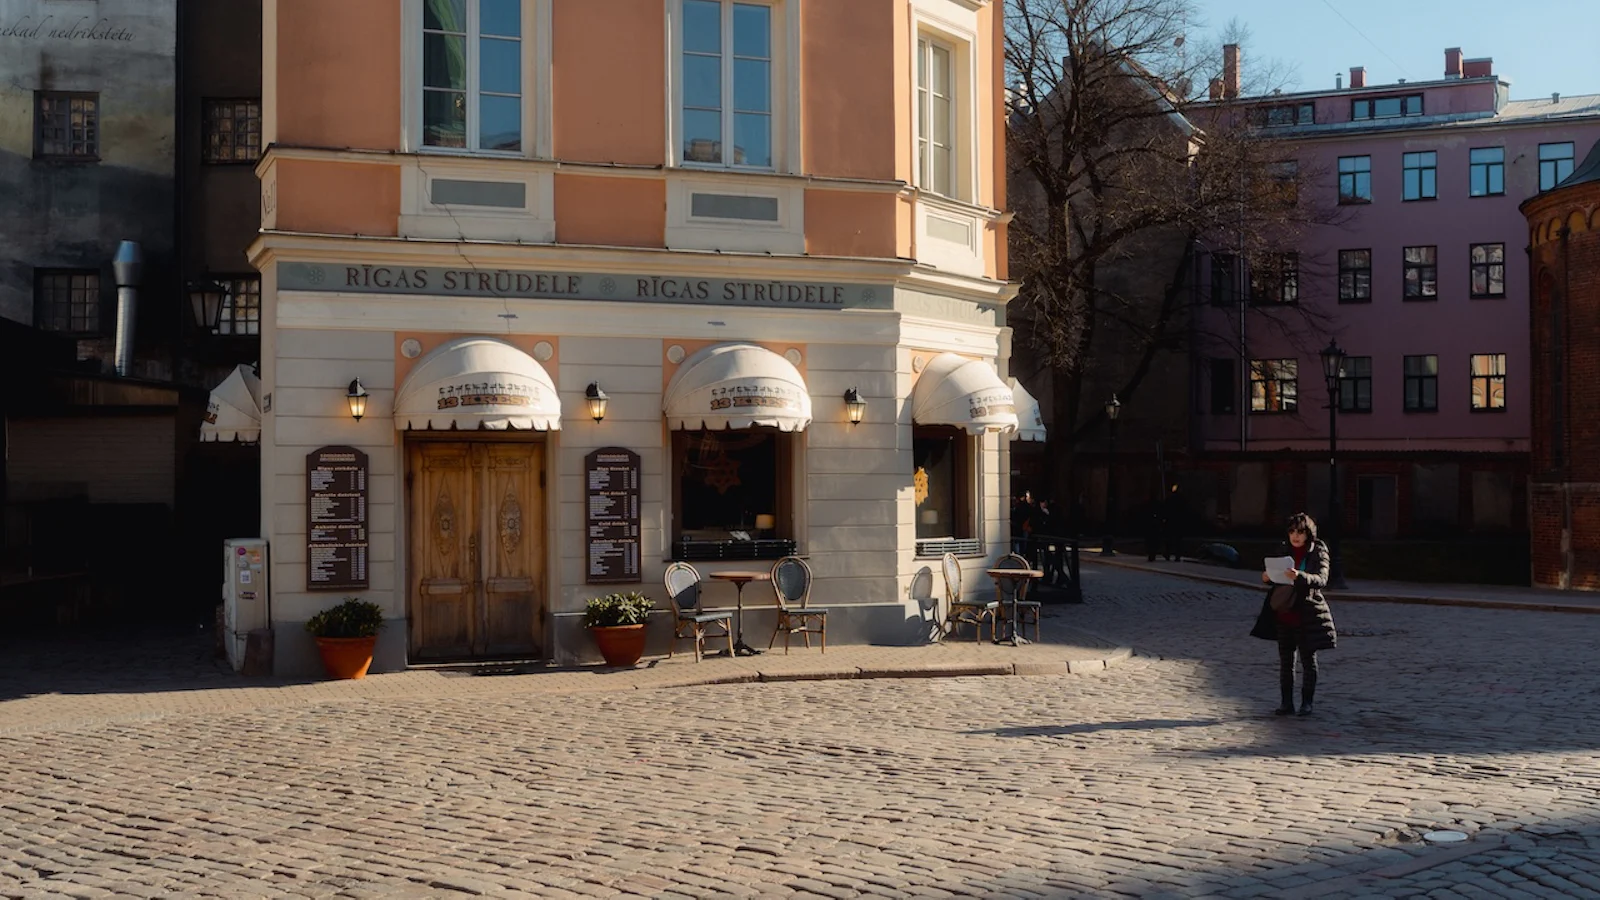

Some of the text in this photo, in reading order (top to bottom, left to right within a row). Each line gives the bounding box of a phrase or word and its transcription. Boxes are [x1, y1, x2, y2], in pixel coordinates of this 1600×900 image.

[0, 15, 53, 39] ekad
[345, 264, 583, 295] RĪGAS STRŪDELE
[636, 276, 845, 305] RĪGAS STRŪDELE
[437, 396, 459, 410] 13
[710, 397, 732, 411] 13
